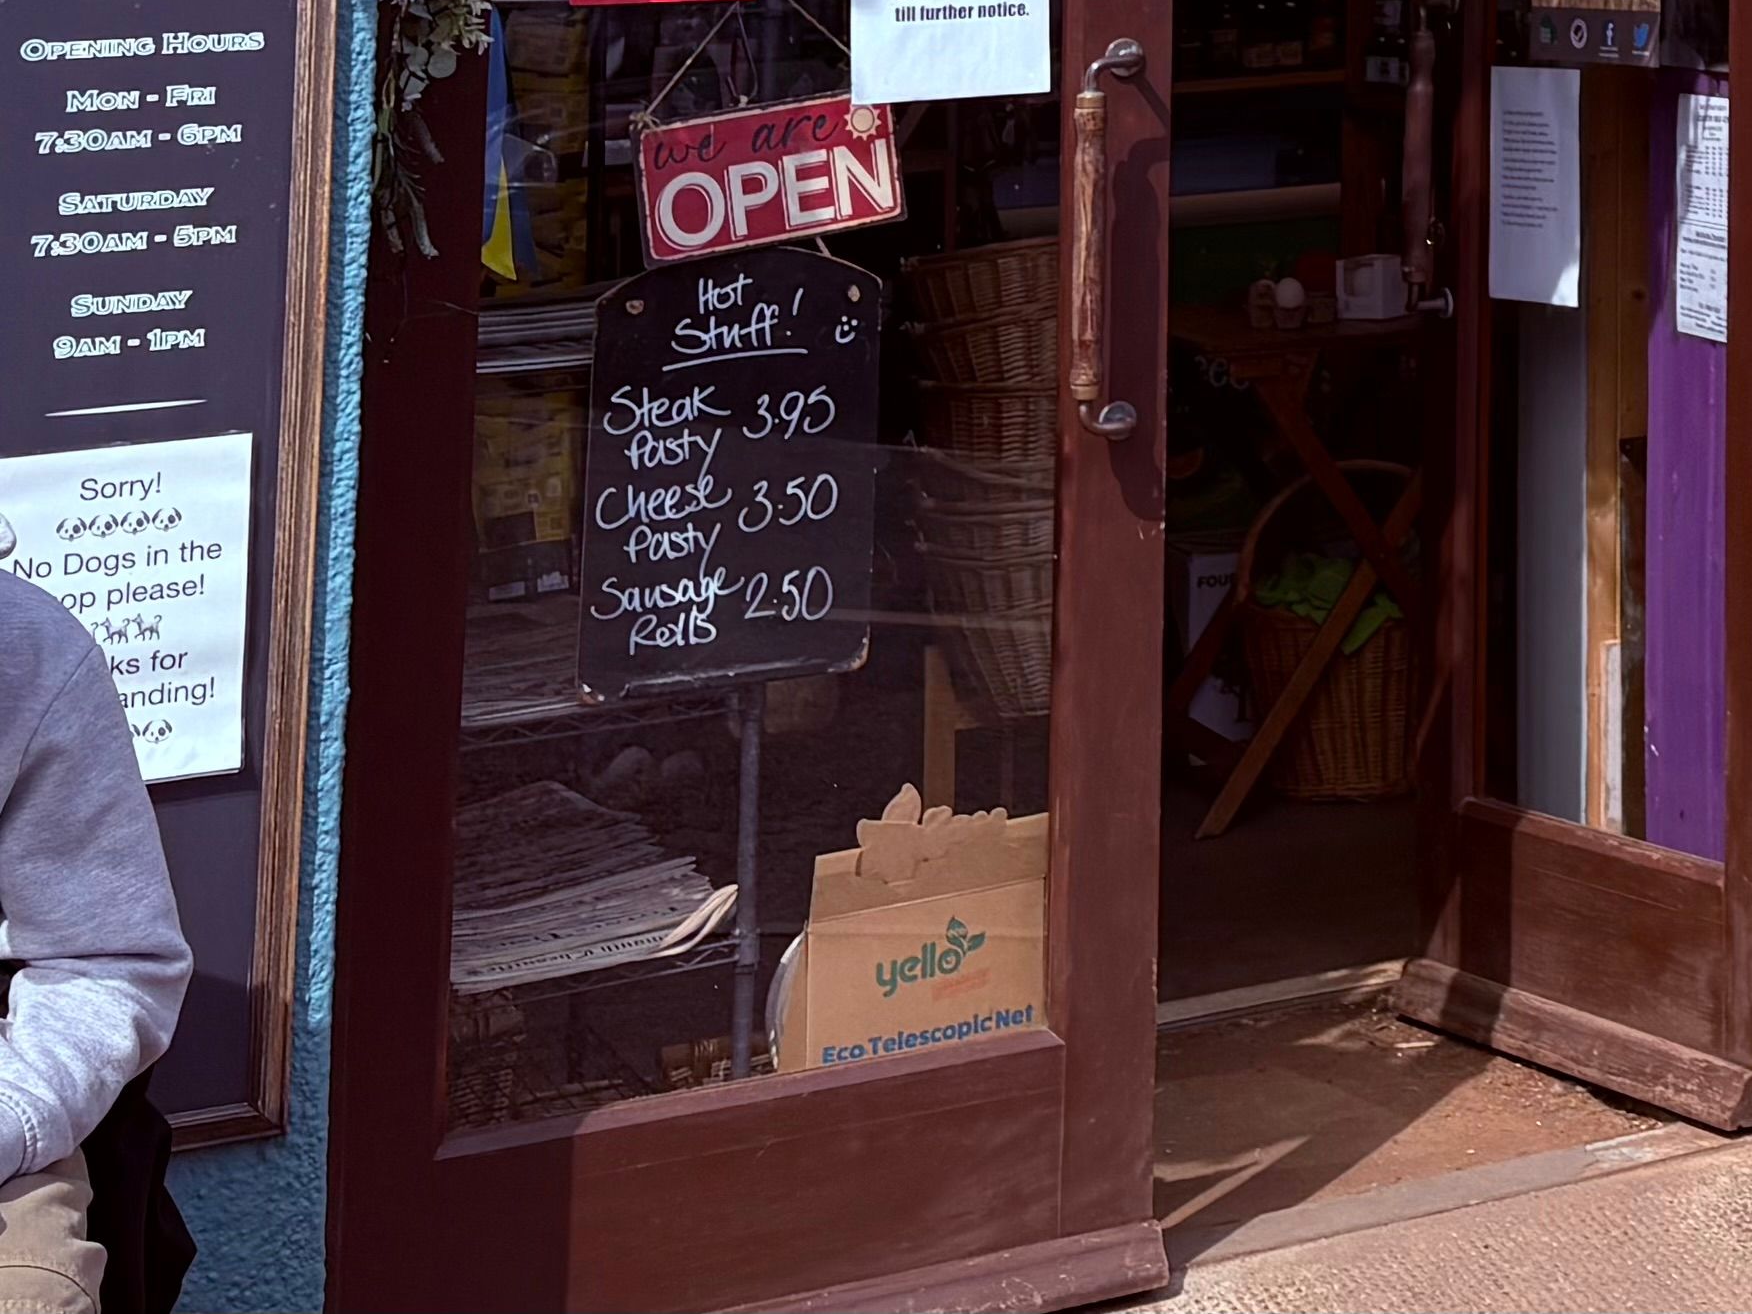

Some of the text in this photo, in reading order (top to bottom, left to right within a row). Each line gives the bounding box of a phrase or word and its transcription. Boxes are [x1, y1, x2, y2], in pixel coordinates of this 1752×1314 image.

[895, 1, 1029, 22] till further notice.
[655, 112, 840, 170] we are
[655, 138, 895, 249] OPEN
[671, 288, 804, 353] Stuff!
[699, 274, 753, 314] Hot
[603, 385, 836, 439] Steak 3.95
[79, 472, 162, 502] Sorry!
[595, 473, 839, 532] Cheese 3.50
[12, 540, 223, 580] No Dogs in the
[106, 574, 206, 607] please!
[591, 565, 834, 622] Sausage 2.50
[149, 649, 188, 673] for
[876, 942, 960, 998] yello
[821, 1004, 1034, 1064] Eco Telescopic Net
